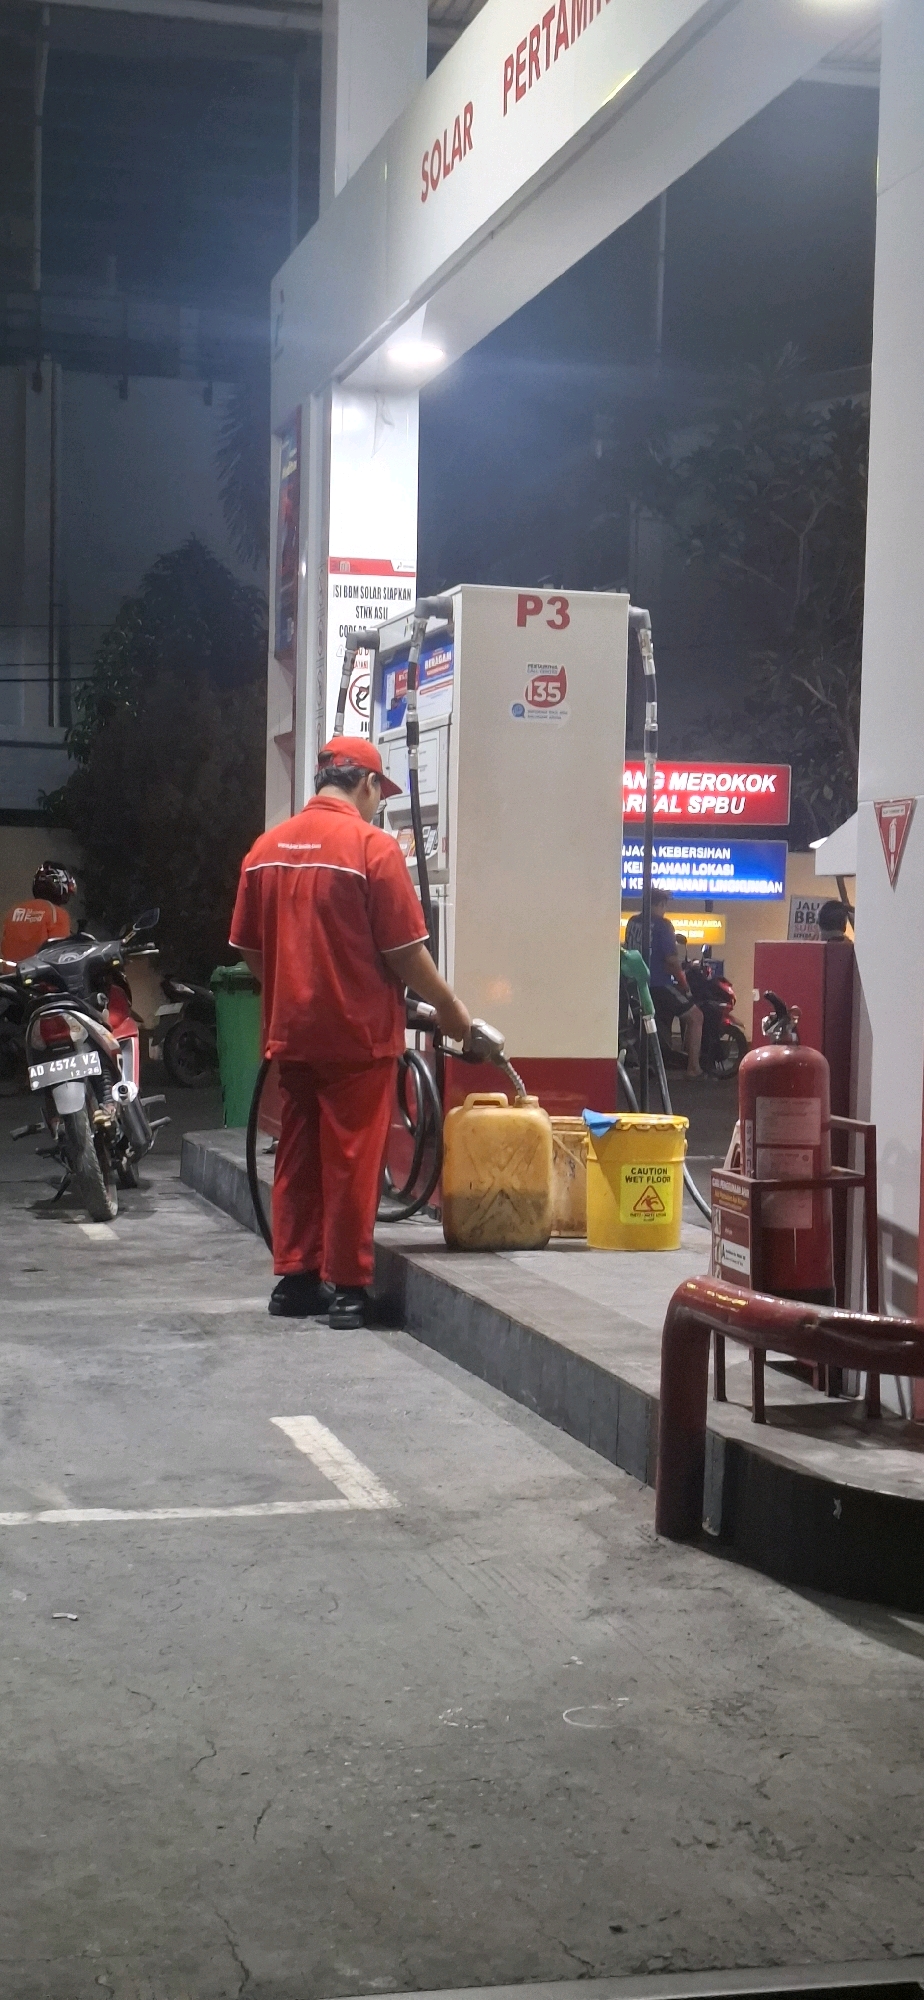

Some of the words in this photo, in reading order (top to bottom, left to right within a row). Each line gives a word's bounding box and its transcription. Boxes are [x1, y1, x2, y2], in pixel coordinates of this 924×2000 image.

[421, 101, 474, 203] SOLAR
[344, 585, 359, 599] BBM
[360, 586, 382, 600] SOLAR
[383, 587, 412, 601] SIAPKAN
[355, 605, 373, 619] STNK
[517, 593, 571, 630] P3
[527, 680, 561, 703] 135
[669, 772, 778, 793] MEROKOK
[687, 796, 746, 815] SPBU
[658, 846, 731, 860] KEBERSIHAN
[692, 863, 735, 876] LOKASI
[709, 880, 783, 894] LINGKUNGAN
[30, 1065, 45, 1078] AD
[49, 1057, 77, 1073] 4574
[82, 1053, 98, 1066] VZ
[631, 1167, 668, 1175] CAUTION
[625, 1175, 644, 1184] WET
[646, 1176, 671, 1184] FLOOR
